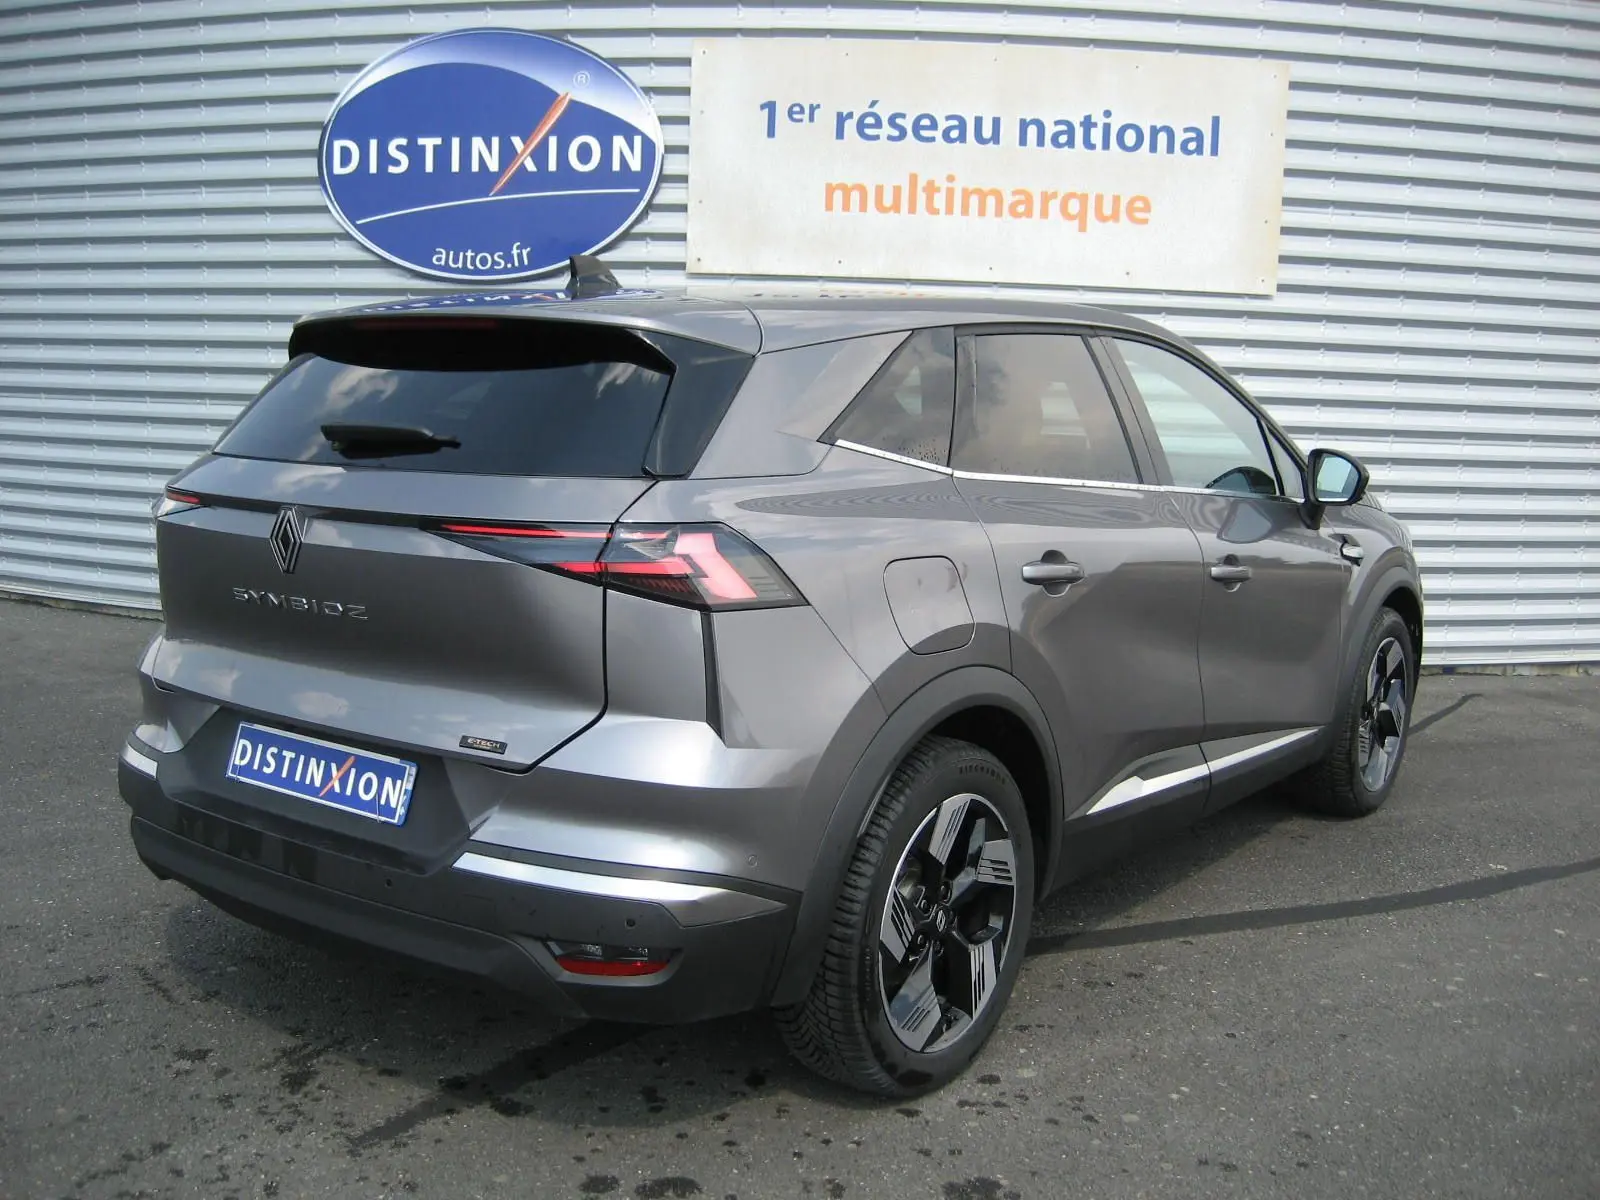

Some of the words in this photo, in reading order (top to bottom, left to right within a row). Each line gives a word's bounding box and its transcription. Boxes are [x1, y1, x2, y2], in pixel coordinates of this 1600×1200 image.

[835, 99, 1001, 145] réseau
[1018, 109, 1221, 157] national
[332, 134, 643, 175] DISTINXION
[824, 172, 1152, 233] multimarque
[432, 241, 532, 271] autos.fr
[232, 587, 369, 621] SYMBIOZ
[233, 737, 403, 810] DISTINXION
